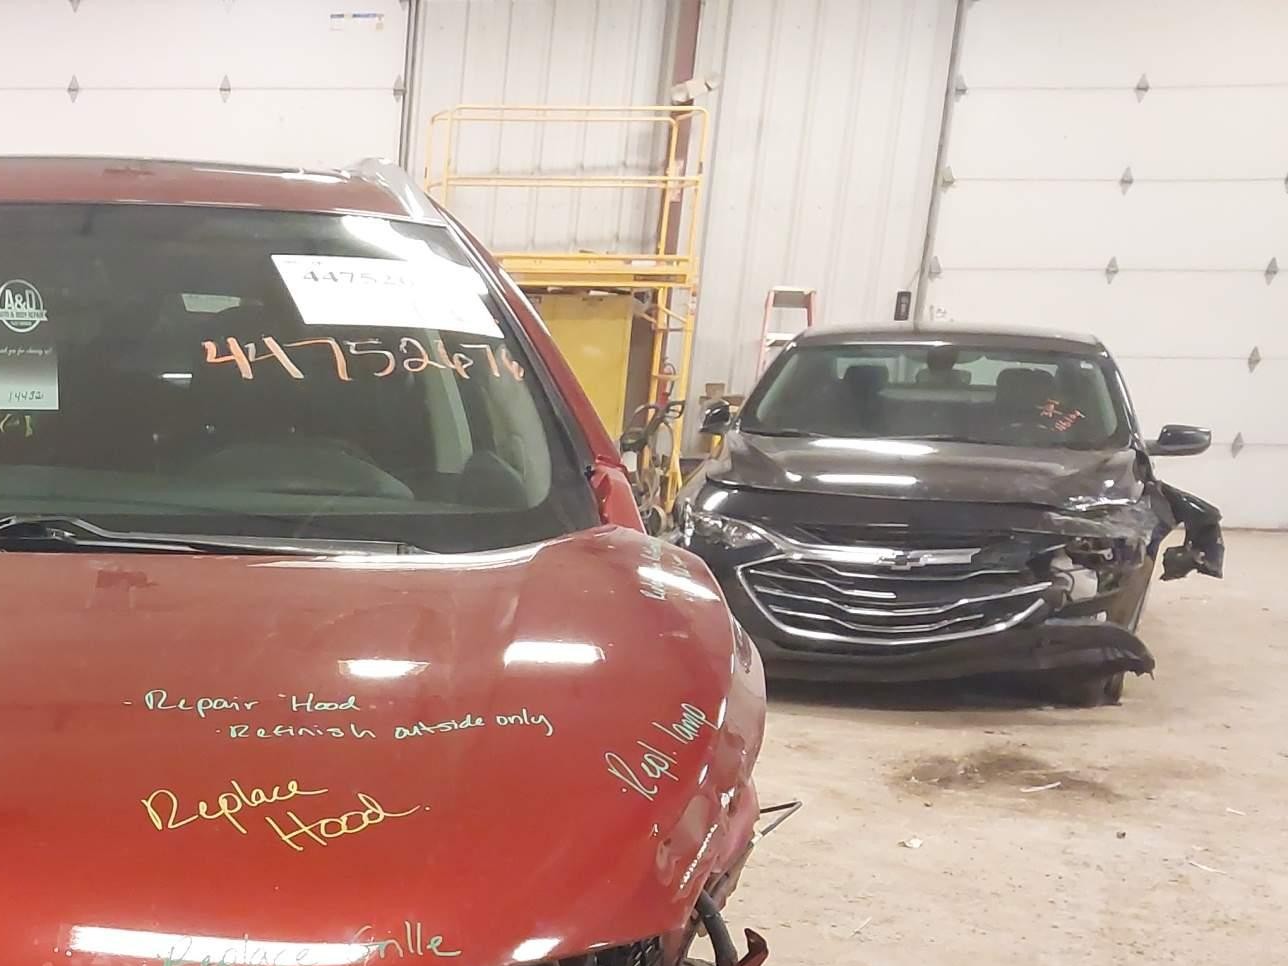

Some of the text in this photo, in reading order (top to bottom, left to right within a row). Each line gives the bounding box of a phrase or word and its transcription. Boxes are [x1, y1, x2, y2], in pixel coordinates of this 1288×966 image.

[4, 289, 36, 311] A&D
[202, 336, 525, 382] 44752676
[145, 689, 260, 718] Repair
[394, 713, 486, 740] outside
[496, 709, 554, 737] only
[141, 780, 329, 835] Replace
